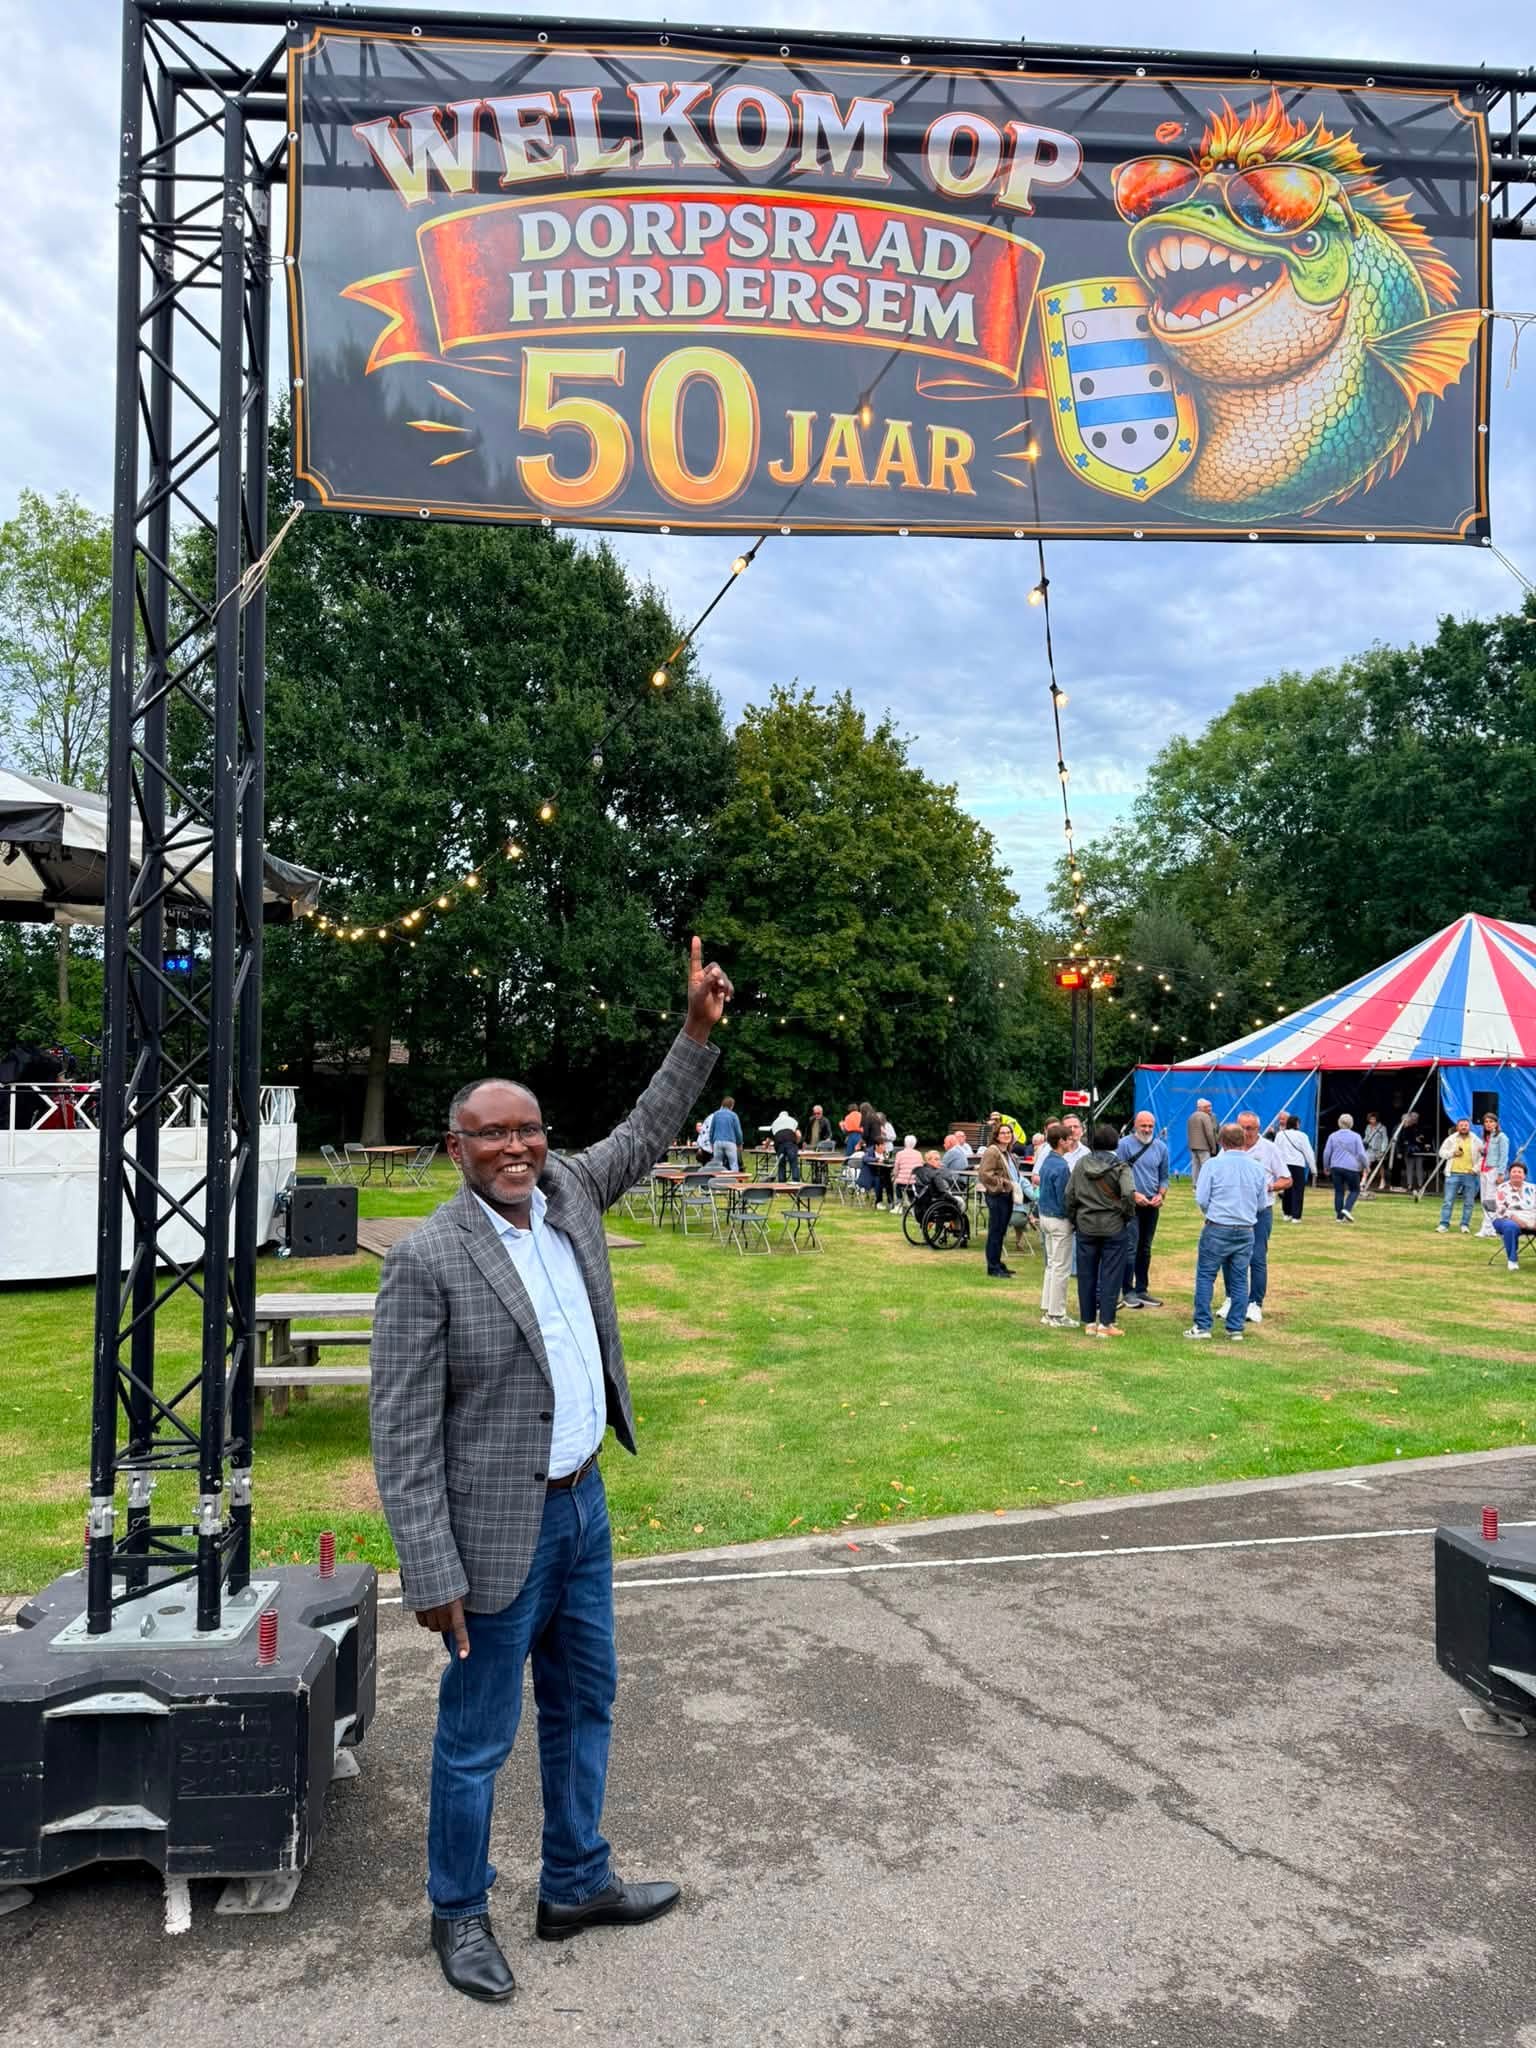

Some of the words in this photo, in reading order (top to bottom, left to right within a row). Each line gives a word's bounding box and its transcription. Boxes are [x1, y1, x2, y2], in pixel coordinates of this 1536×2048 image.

[354, 81, 894, 207] WELKOM
[925, 112, 1083, 214] OP
[518, 203, 972, 282] DORPSRAAD
[509, 265, 979, 346] HERDERSEM
[516, 346, 761, 509] 50
[768, 410, 977, 496] JAAR
